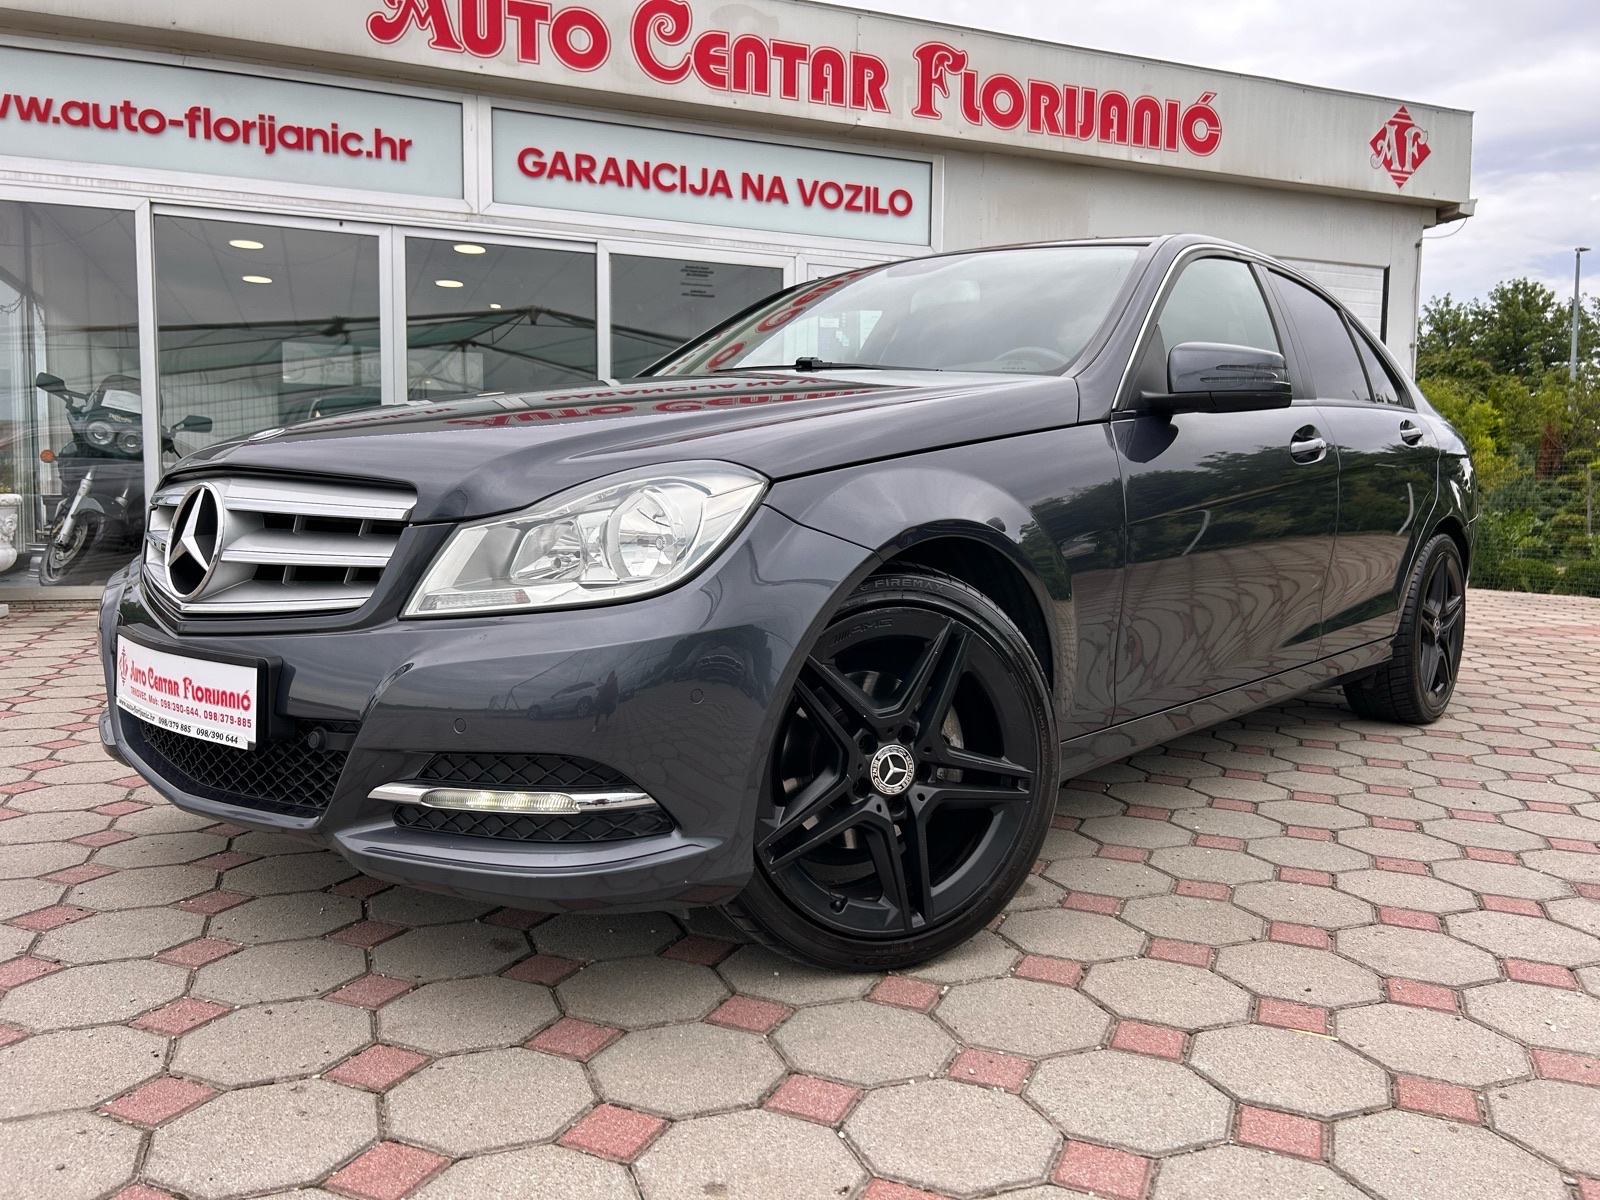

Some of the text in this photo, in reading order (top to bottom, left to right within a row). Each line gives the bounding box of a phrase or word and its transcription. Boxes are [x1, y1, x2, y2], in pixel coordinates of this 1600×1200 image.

[630, 0, 891, 114] CENTAR
[516, 147, 914, 218] GARANCIJA NA VOZILO
[148, 666, 180, 697] CENTAR
[196, 727, 224, 741] 098/390
[225, 734, 238, 744] 644
